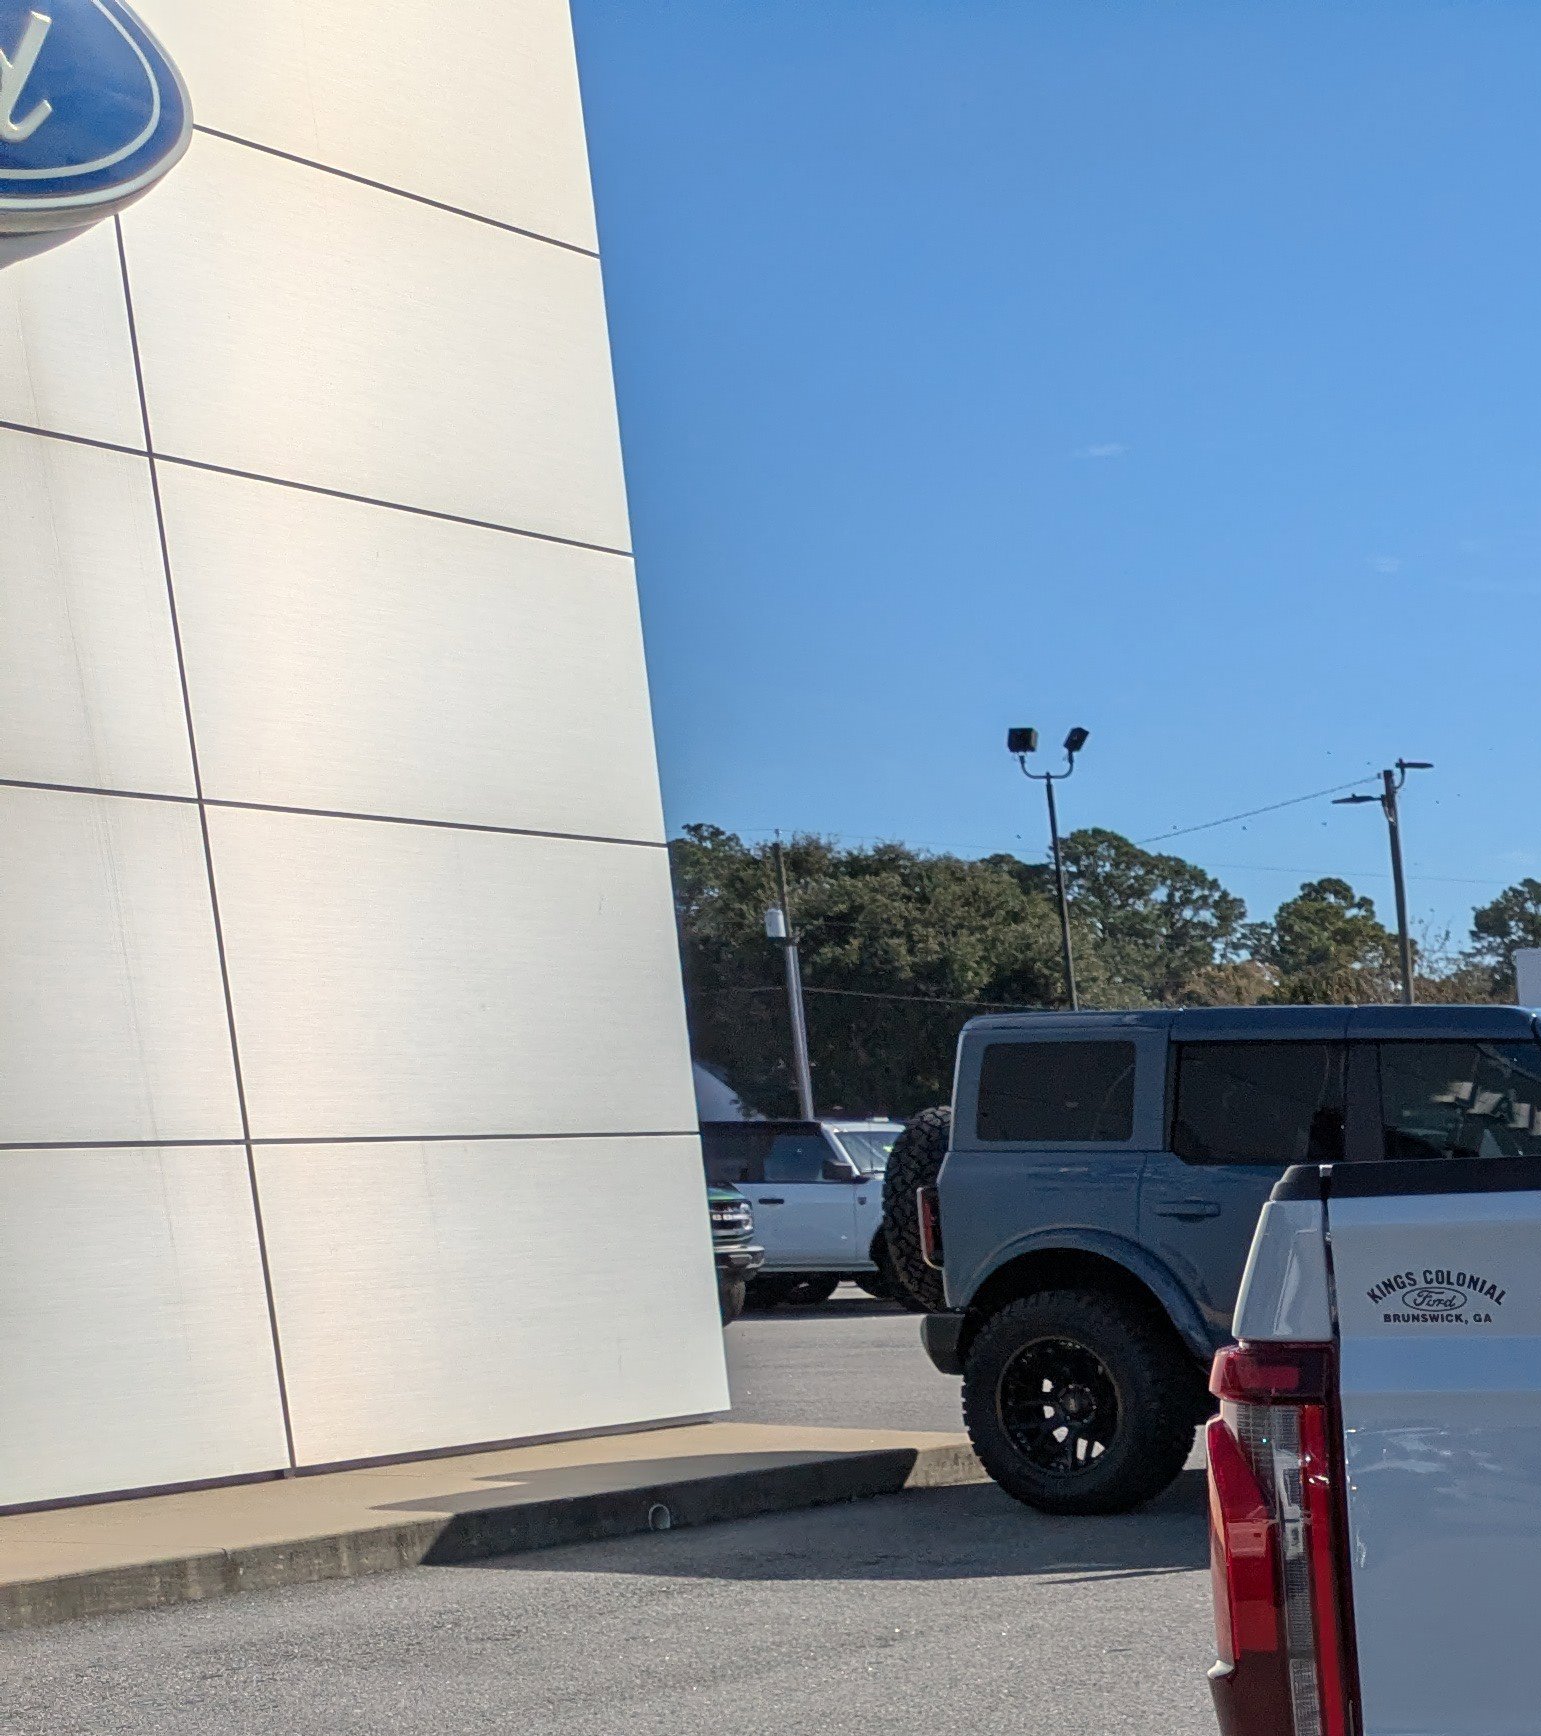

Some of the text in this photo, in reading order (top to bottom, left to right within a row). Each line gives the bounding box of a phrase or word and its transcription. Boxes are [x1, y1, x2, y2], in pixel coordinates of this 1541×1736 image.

[1367, 1269, 1507, 1306] KINGS COLONIAL
[1413, 1288, 1457, 1308] Ford
[1383, 1313, 1493, 1325] BRUNSWICK, GA
